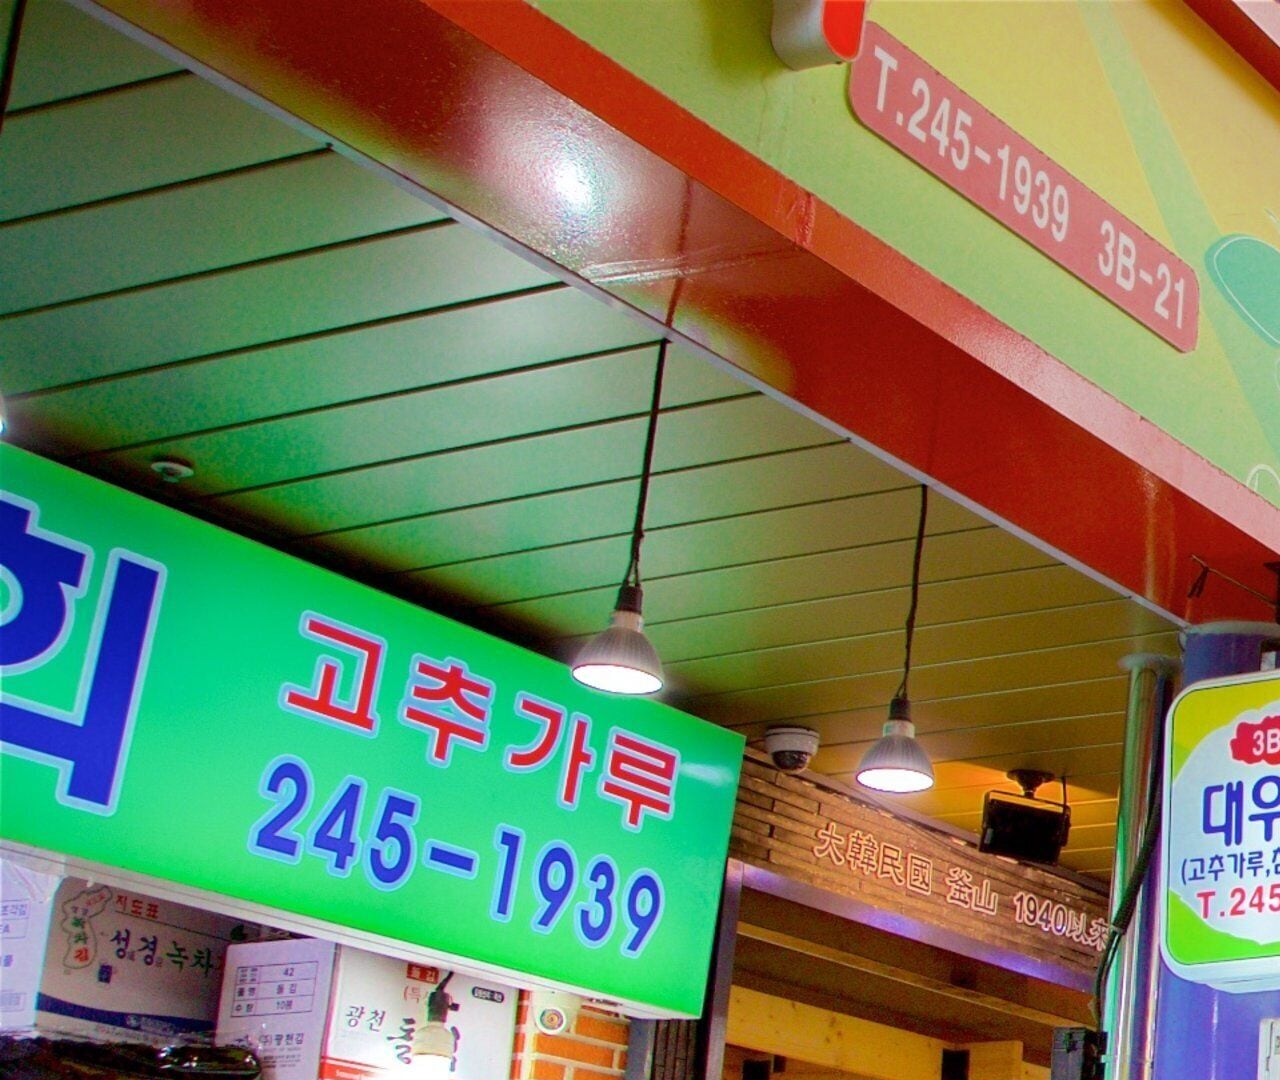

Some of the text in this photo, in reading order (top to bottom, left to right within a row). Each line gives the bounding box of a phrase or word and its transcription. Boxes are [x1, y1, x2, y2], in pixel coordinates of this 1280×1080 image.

[873, 45, 1186, 329] T.245-1939 3B-21
[281, 611, 680, 832] 고추가루
[249, 755, 667, 957] 245-1939
[813, 822, 933, 896] 大韓民國
[945, 867, 998, 917] 釜山
[346, 1005, 387, 1032] 광천
